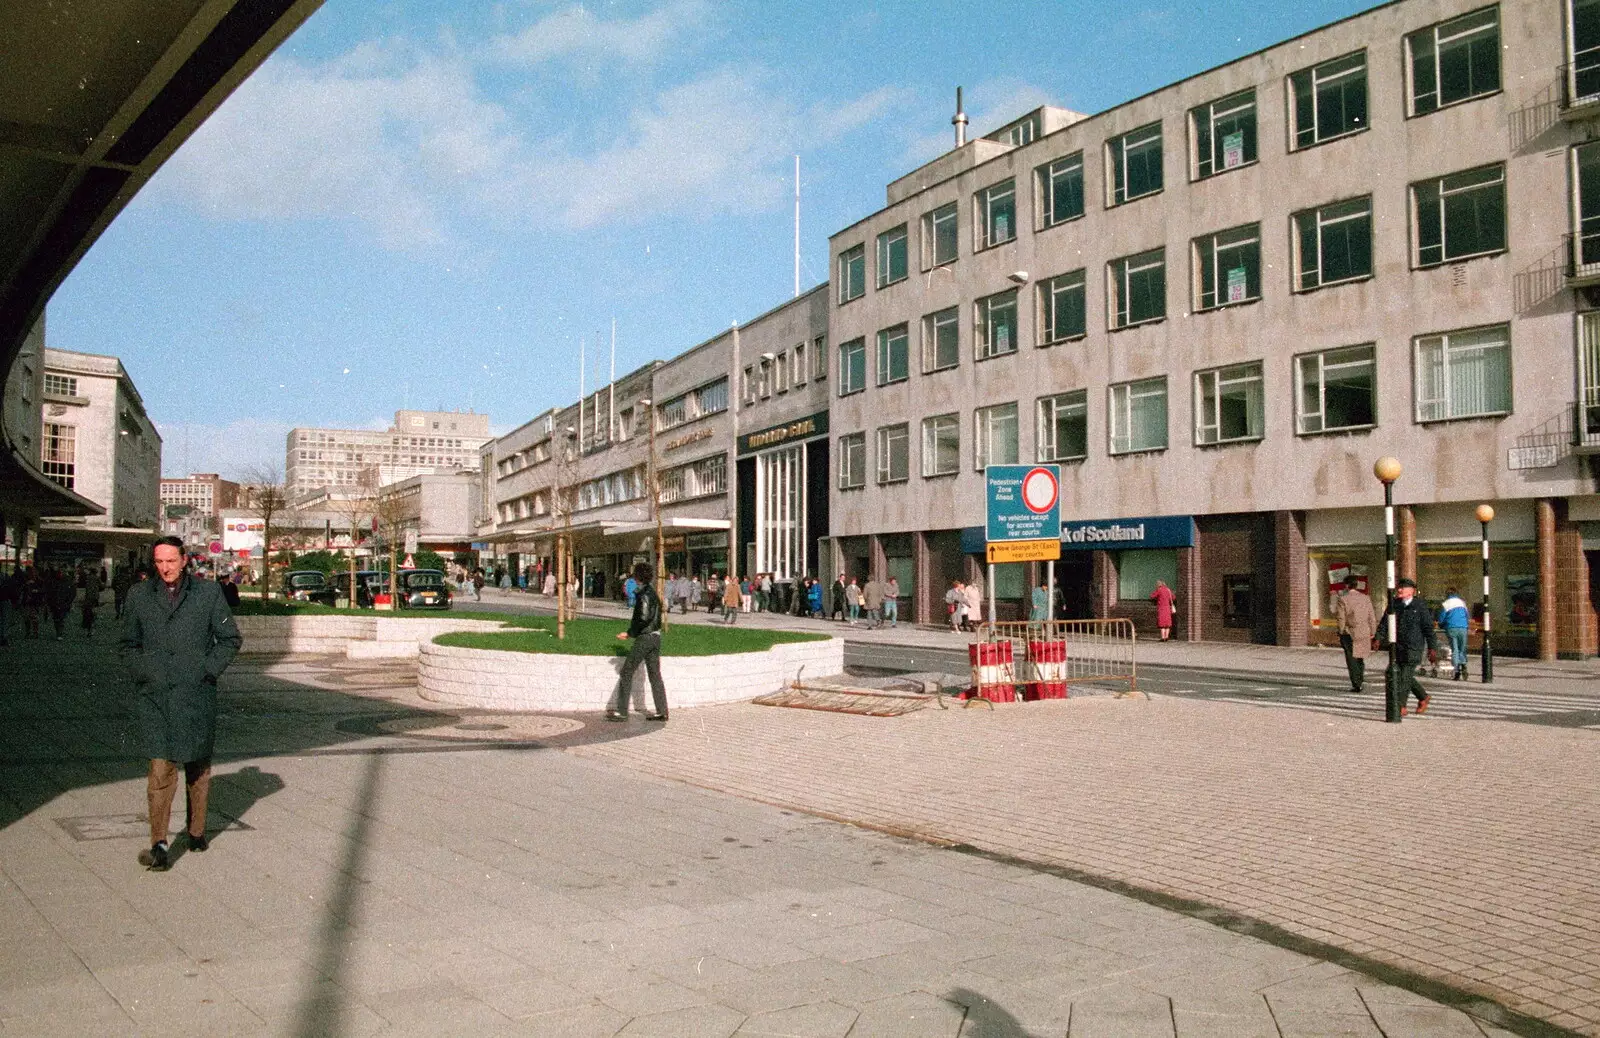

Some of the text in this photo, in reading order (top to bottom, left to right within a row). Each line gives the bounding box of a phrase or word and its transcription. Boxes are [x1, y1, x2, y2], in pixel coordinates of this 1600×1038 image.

[1072, 526, 1086, 542] of
[1086, 523, 1145, 542] Scotland
[1011, 543, 1031, 552] George
